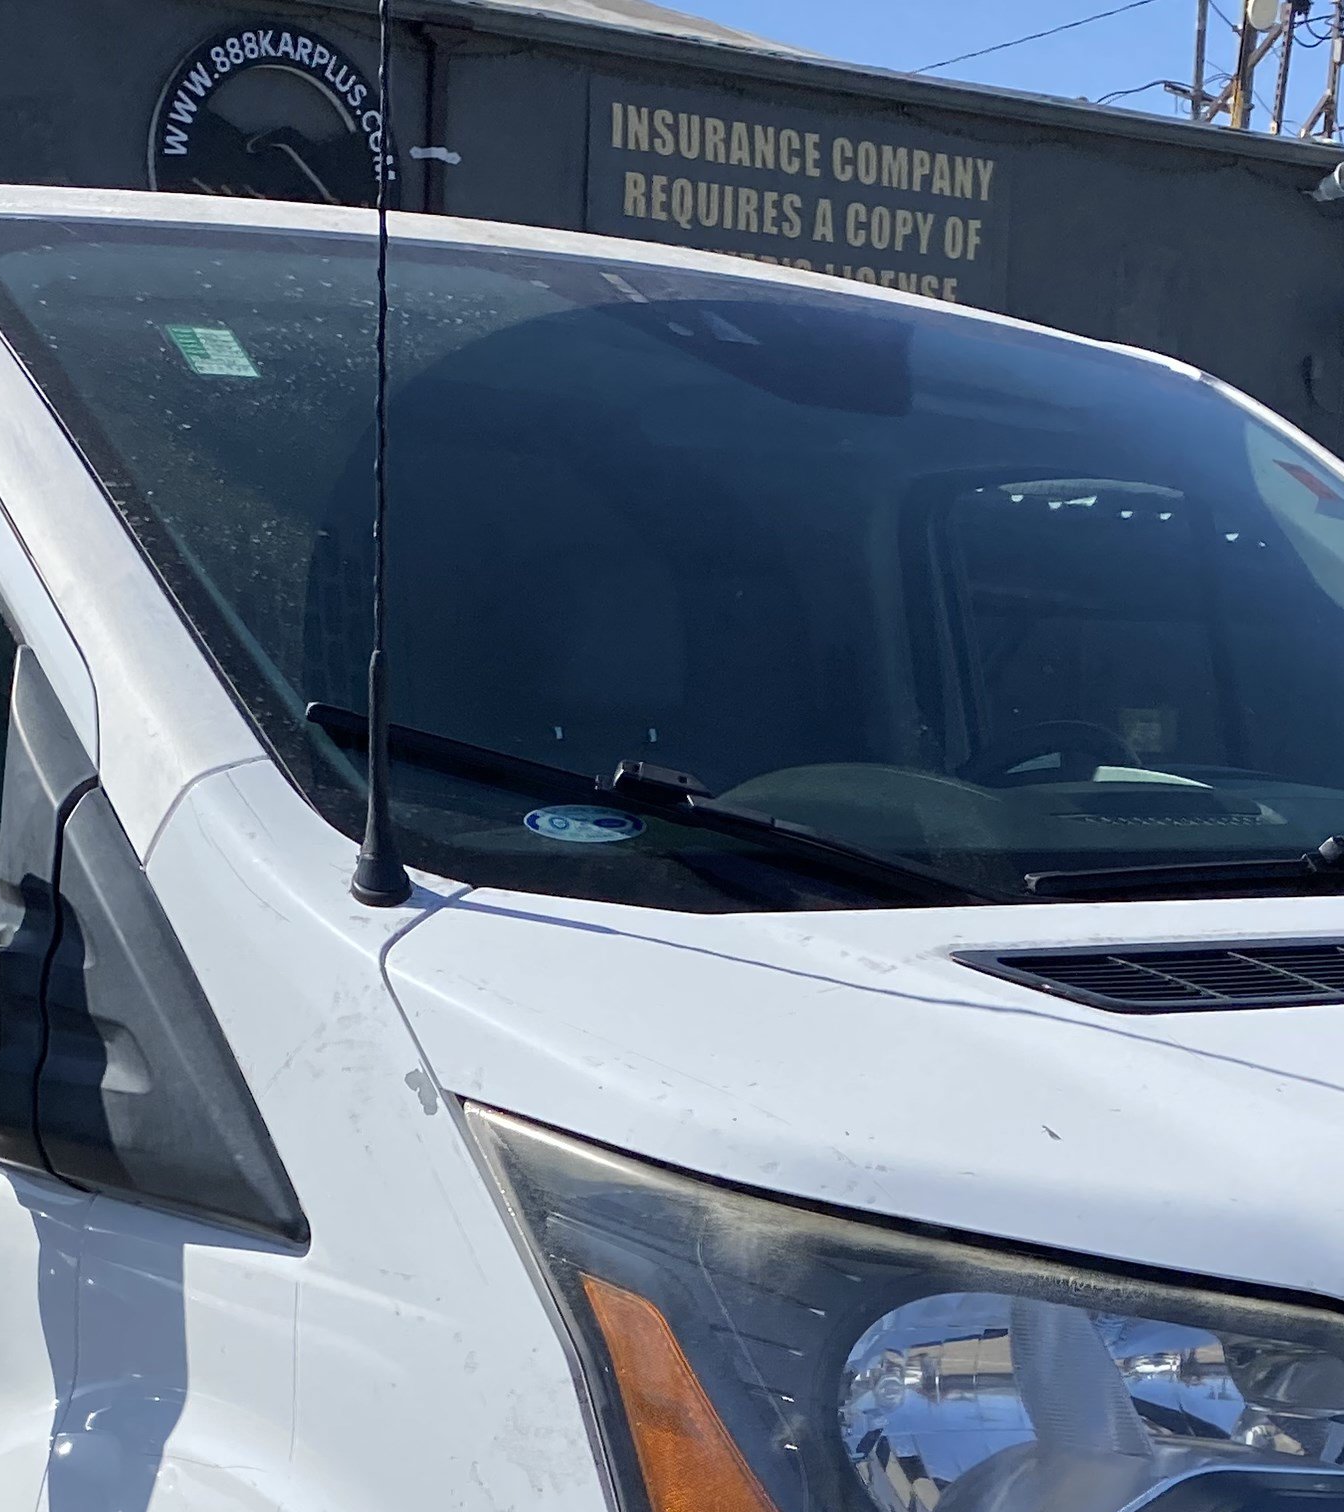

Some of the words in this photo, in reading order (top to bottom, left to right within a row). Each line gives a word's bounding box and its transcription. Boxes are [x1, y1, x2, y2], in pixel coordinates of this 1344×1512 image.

[611, 102, 821, 178] INSURANCE
[832, 136, 995, 202] COMPANY
[623, 171, 803, 239] REQUIRES
[812, 198, 834, 243] A
[845, 202, 935, 255] COPY
[944, 215, 982, 261] OF
